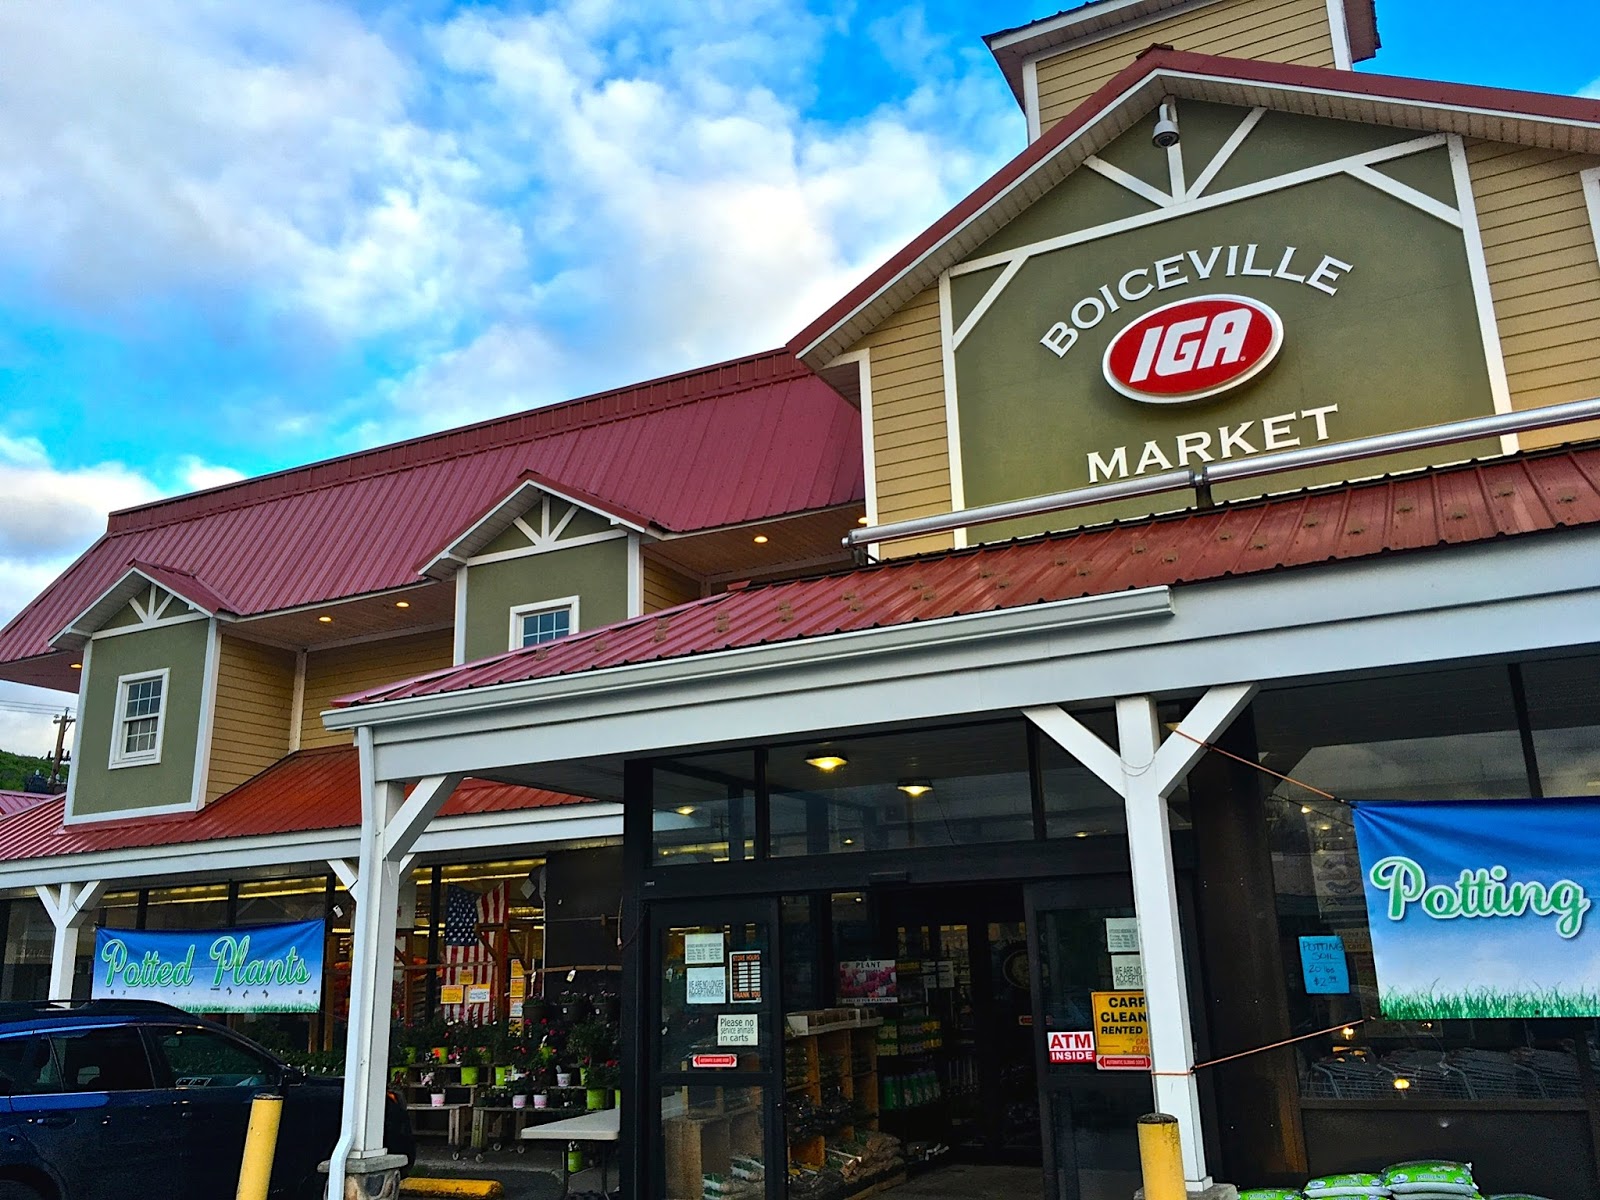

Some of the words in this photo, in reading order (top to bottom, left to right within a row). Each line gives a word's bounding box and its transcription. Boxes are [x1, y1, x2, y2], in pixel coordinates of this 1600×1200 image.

[1039, 243, 1354, 358] BOICEVILLE
[1129, 308, 1253, 383] IGA
[1086, 403, 1340, 484] MARKET
[1370, 856, 1591, 938] Potting
[1302, 941, 1344, 952] POTTING
[101, 939, 196, 987] Potted
[210, 935, 311, 986] Plants
[746, 953, 760, 961] HOURS
[1311, 952, 1339, 960] SOIL
[1308, 964, 1320, 973] 20
[1100, 1012, 1147, 1022] CLEAN
[720, 1018, 743, 1027] Please
[1101, 1026, 1143, 1034] RENTED
[729, 1034, 749, 1042] carts
[1050, 1034, 1092, 1049] ATM
[1051, 1051, 1093, 1060] INSIDE
